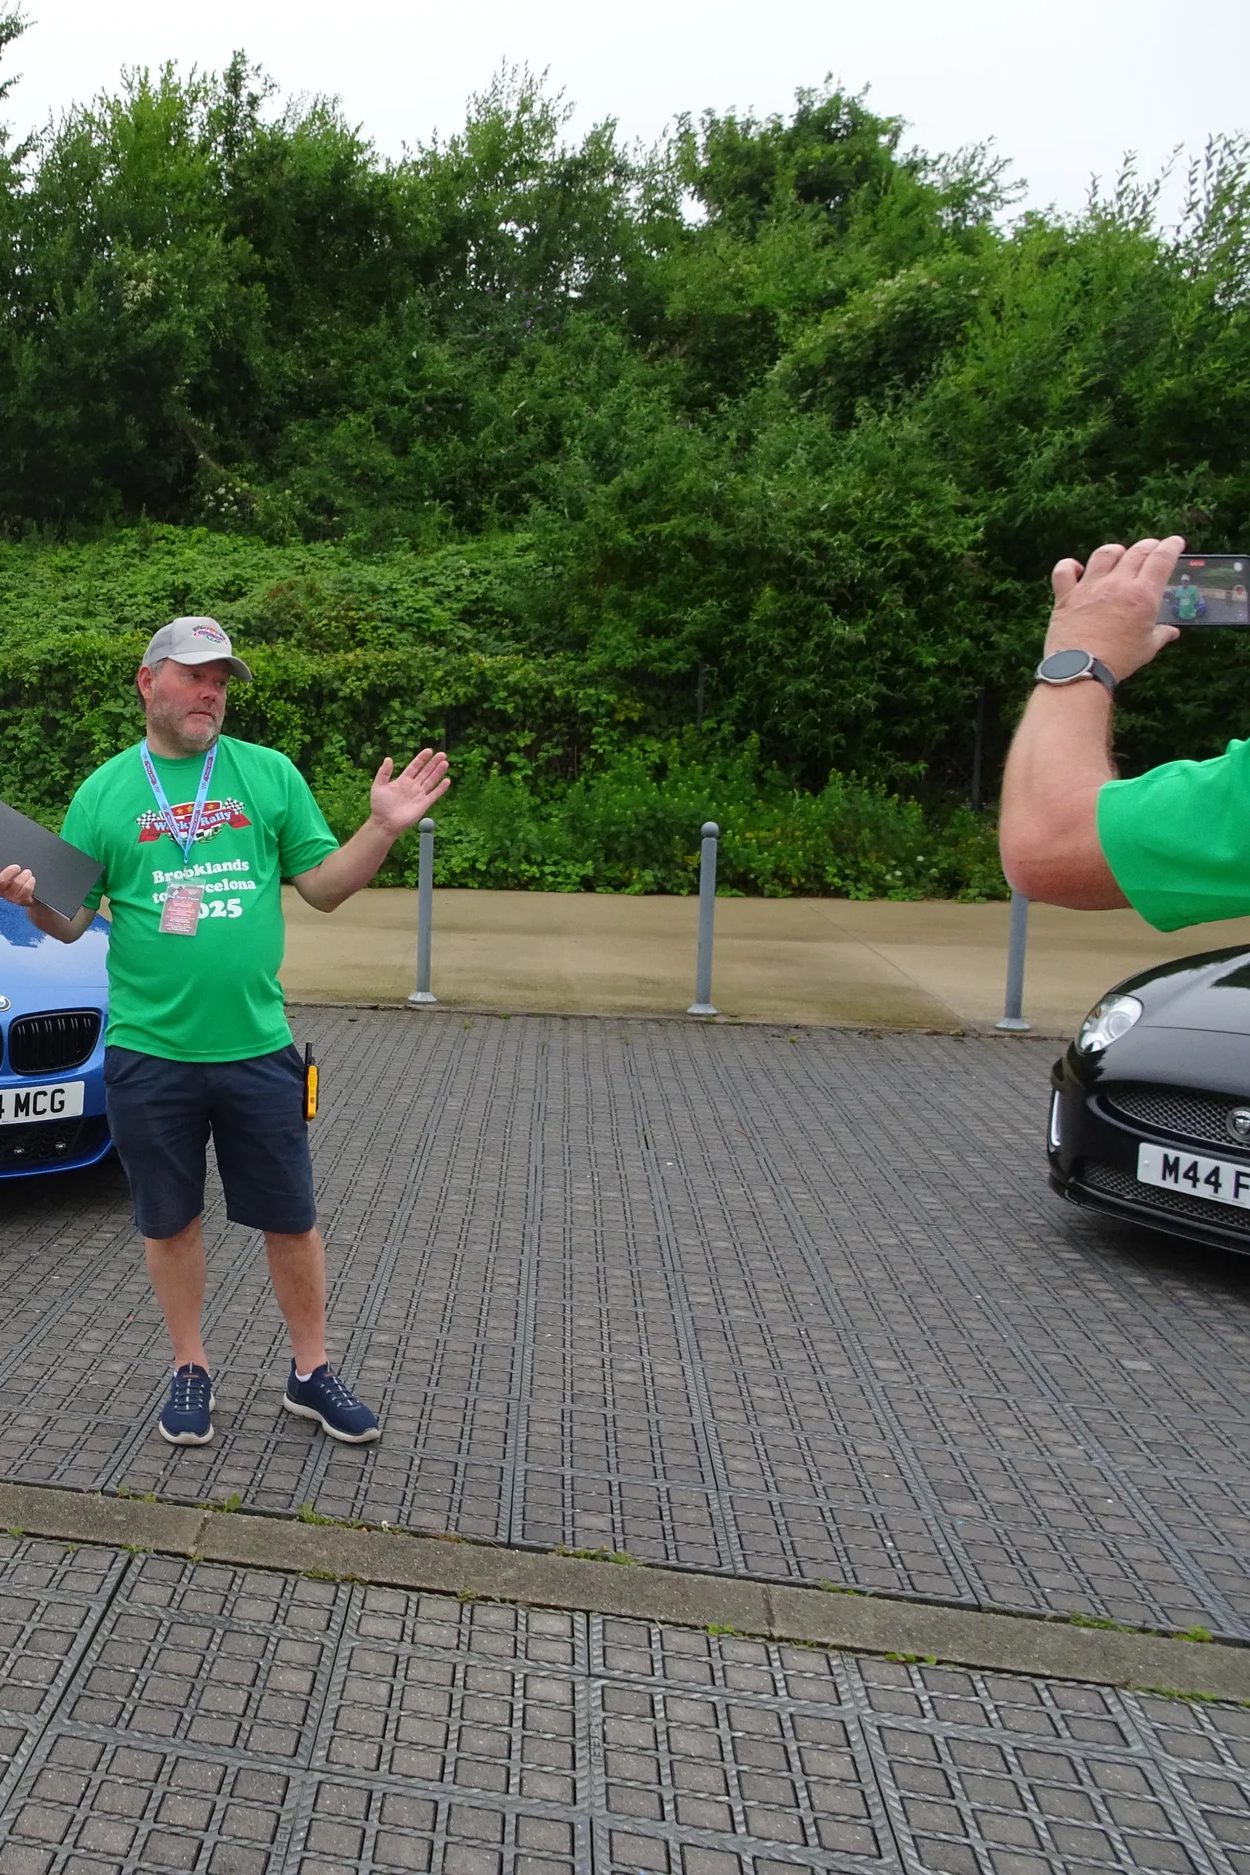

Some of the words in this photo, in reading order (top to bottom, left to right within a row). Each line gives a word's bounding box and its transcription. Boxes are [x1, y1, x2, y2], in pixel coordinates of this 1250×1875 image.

[199, 811, 231, 826] Rally
[152, 858, 250, 884] Brooklands
[152, 892, 168, 904] to
[204, 878, 257, 893] celona
[196, 898, 243, 919] 025
[14, 1088, 66, 1118] MCG
[1161, 1153, 1222, 1194] M44
